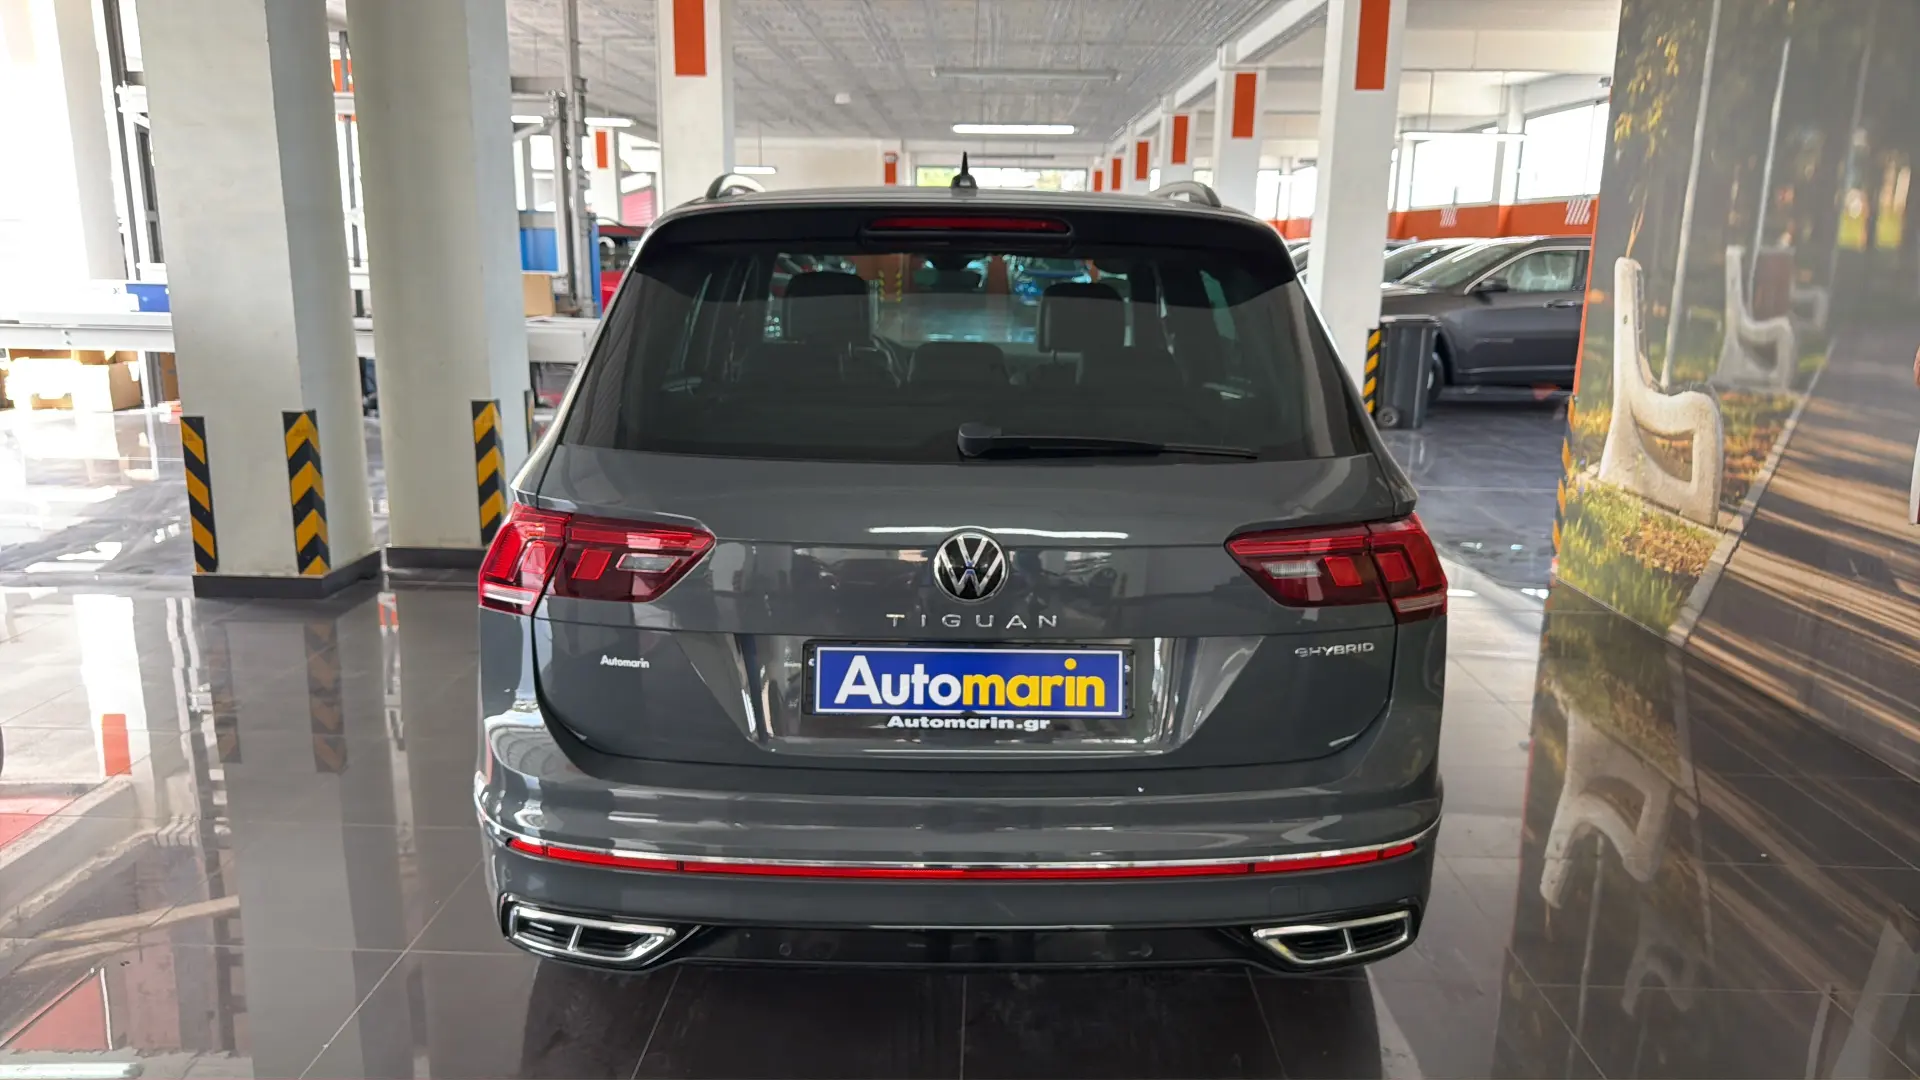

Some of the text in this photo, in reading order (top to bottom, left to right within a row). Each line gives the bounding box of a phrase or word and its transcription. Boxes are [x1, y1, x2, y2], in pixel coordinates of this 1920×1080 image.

[885, 613, 1057, 630] TIGUAN
[600, 654, 650, 669] Automarin
[833, 655, 1106, 707] Automarin
[886, 714, 1051, 732] Automarin.gr
